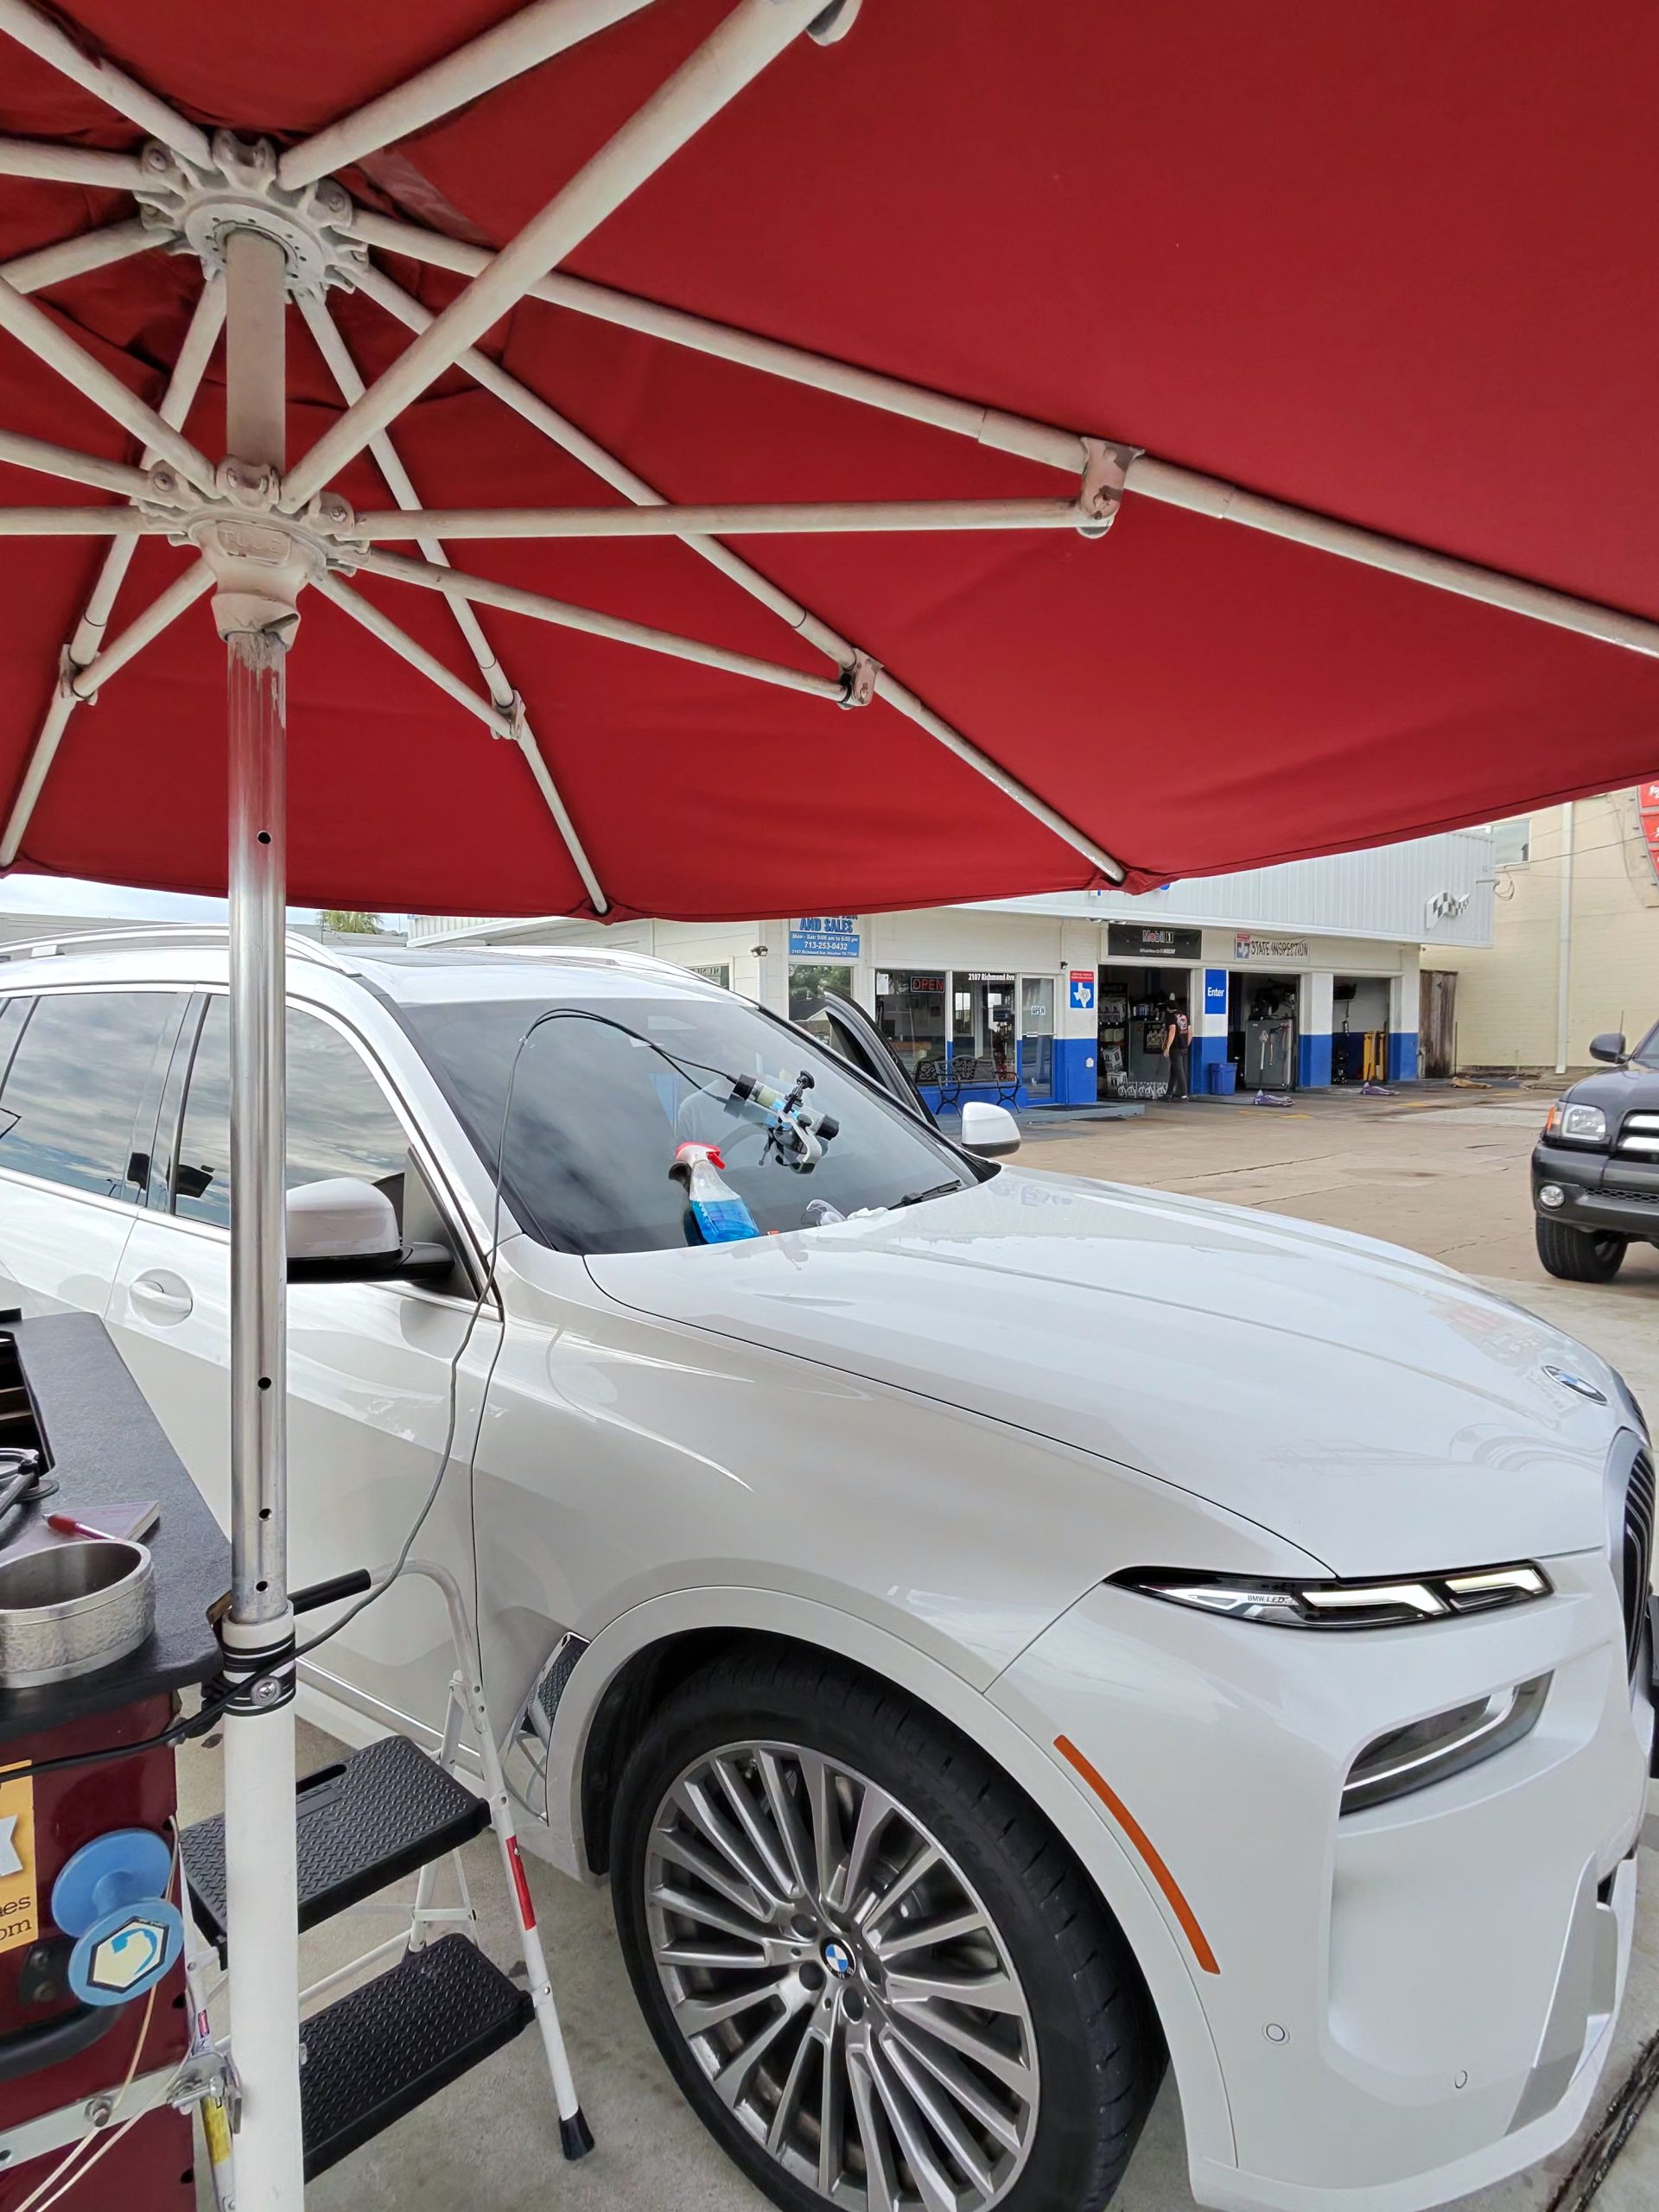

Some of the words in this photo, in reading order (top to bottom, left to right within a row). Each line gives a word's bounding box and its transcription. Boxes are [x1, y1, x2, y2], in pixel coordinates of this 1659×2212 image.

[799, 918, 822, 931] AND
[824, 918, 854, 933] SALES
[1142, 929, 1165, 943] Mobil
[804, 941, 848, 950] 713-253-0432
[1250, 940, 1270, 956] STATE
[1271, 942, 1308, 957] INSPECTION
[912, 978, 944, 990] OPEN
[1207, 987, 1225, 997] Enter
